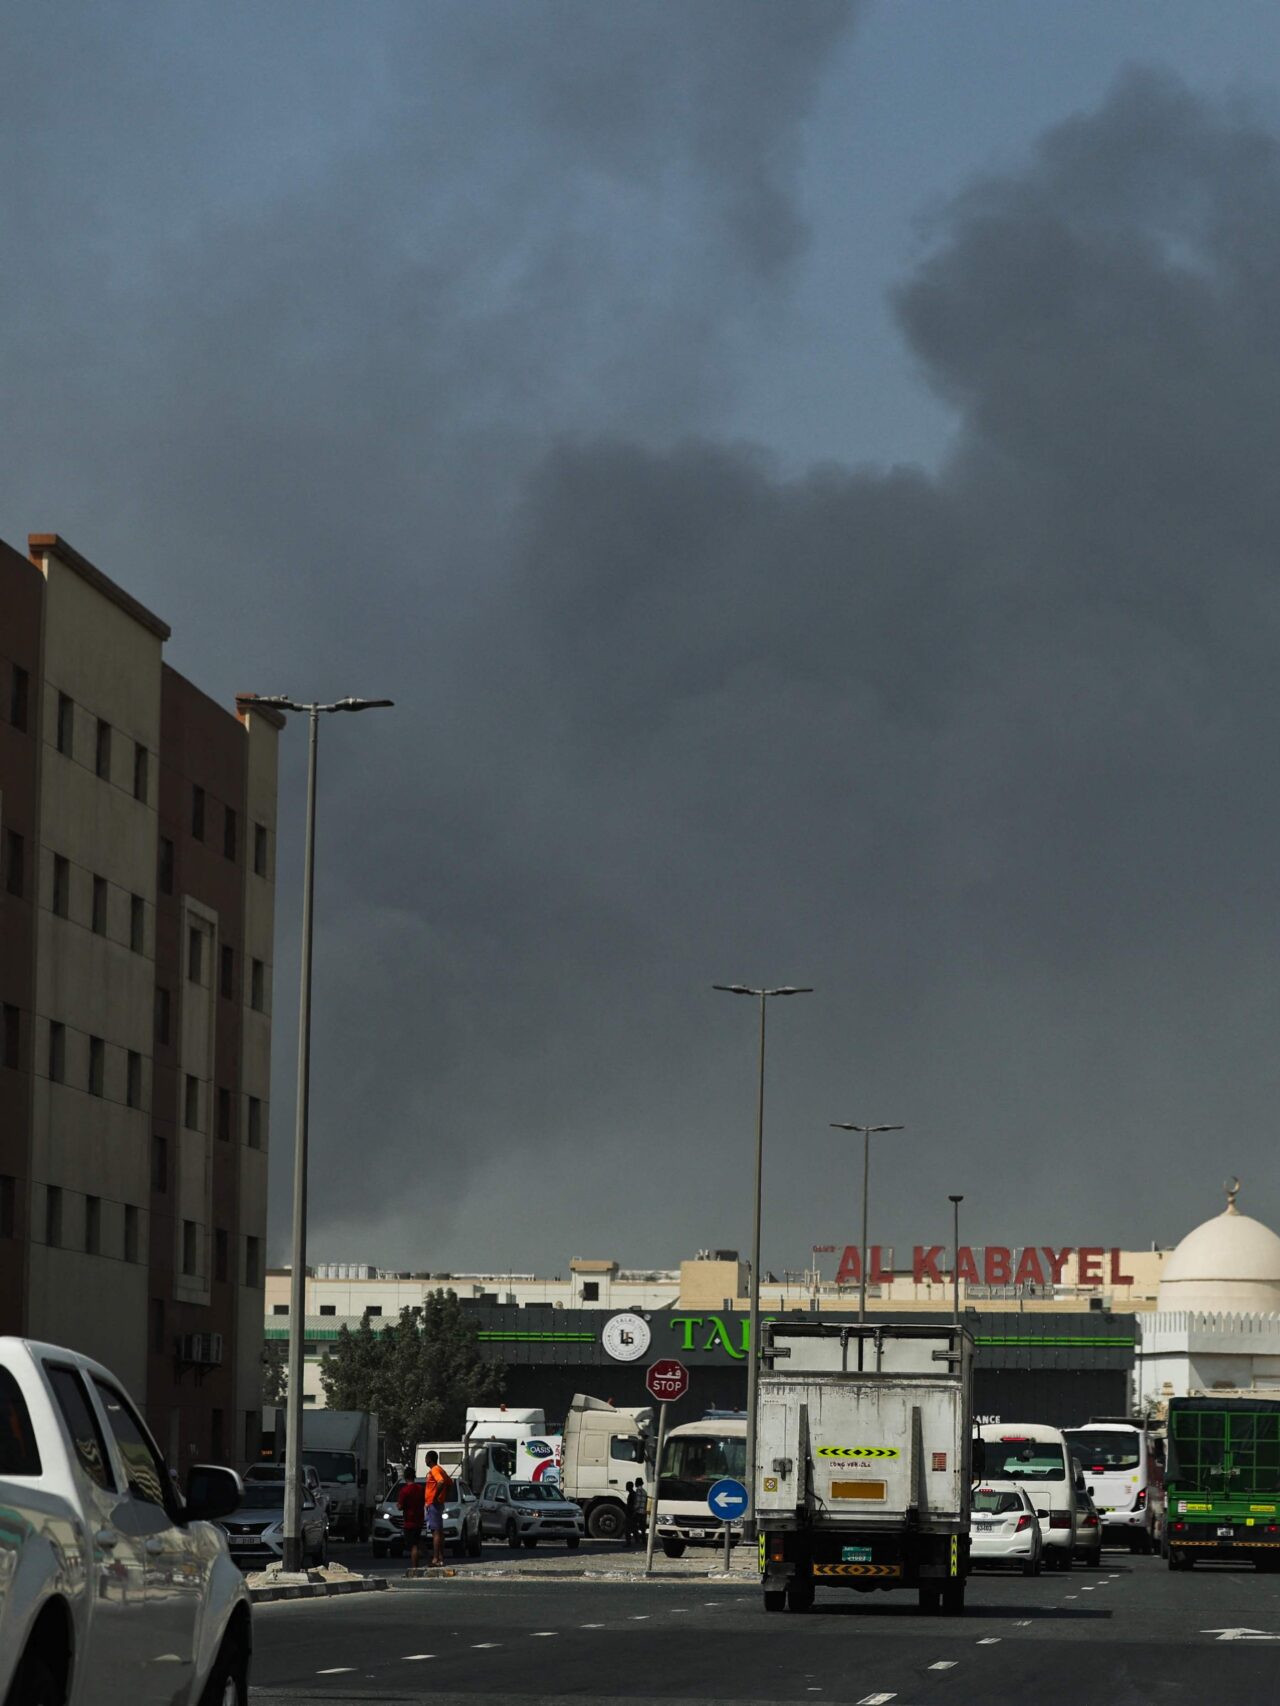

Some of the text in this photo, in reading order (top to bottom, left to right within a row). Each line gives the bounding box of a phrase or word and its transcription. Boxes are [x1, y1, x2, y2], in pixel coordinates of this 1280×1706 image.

[836, 1245, 1134, 1285] AL KABAYEL
[654, 1366, 682, 1379] قف
[653, 1380, 682, 1391] STOP
